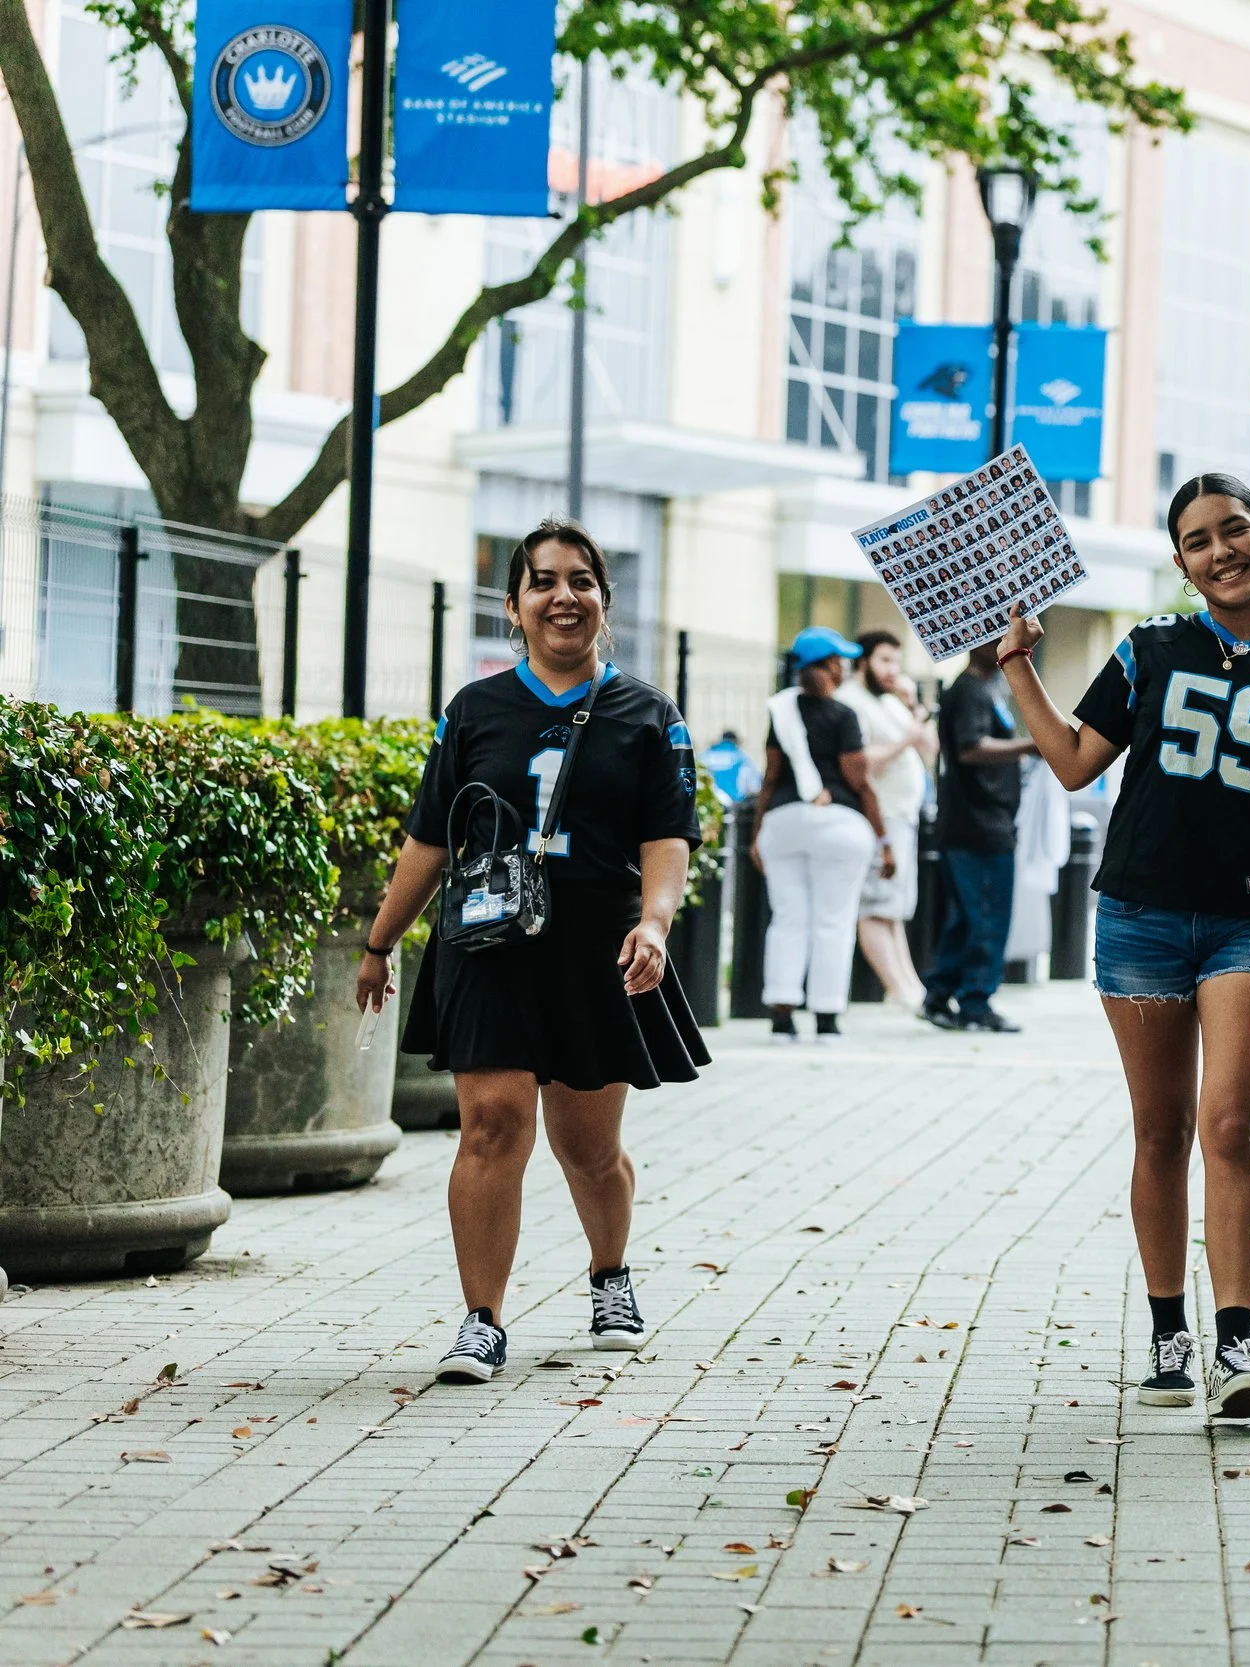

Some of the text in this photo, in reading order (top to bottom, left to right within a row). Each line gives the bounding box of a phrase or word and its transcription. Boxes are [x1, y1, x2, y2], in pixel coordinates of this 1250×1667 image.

[224, 30, 317, 65] CHARLOTTE
[403, 98, 543, 114] BANK OF AMERICA
[436, 112, 509, 126] STADIUM
[859, 527, 892, 548] PLAYER
[896, 509, 930, 531] ROSTER
[525, 747, 571, 858] 1
